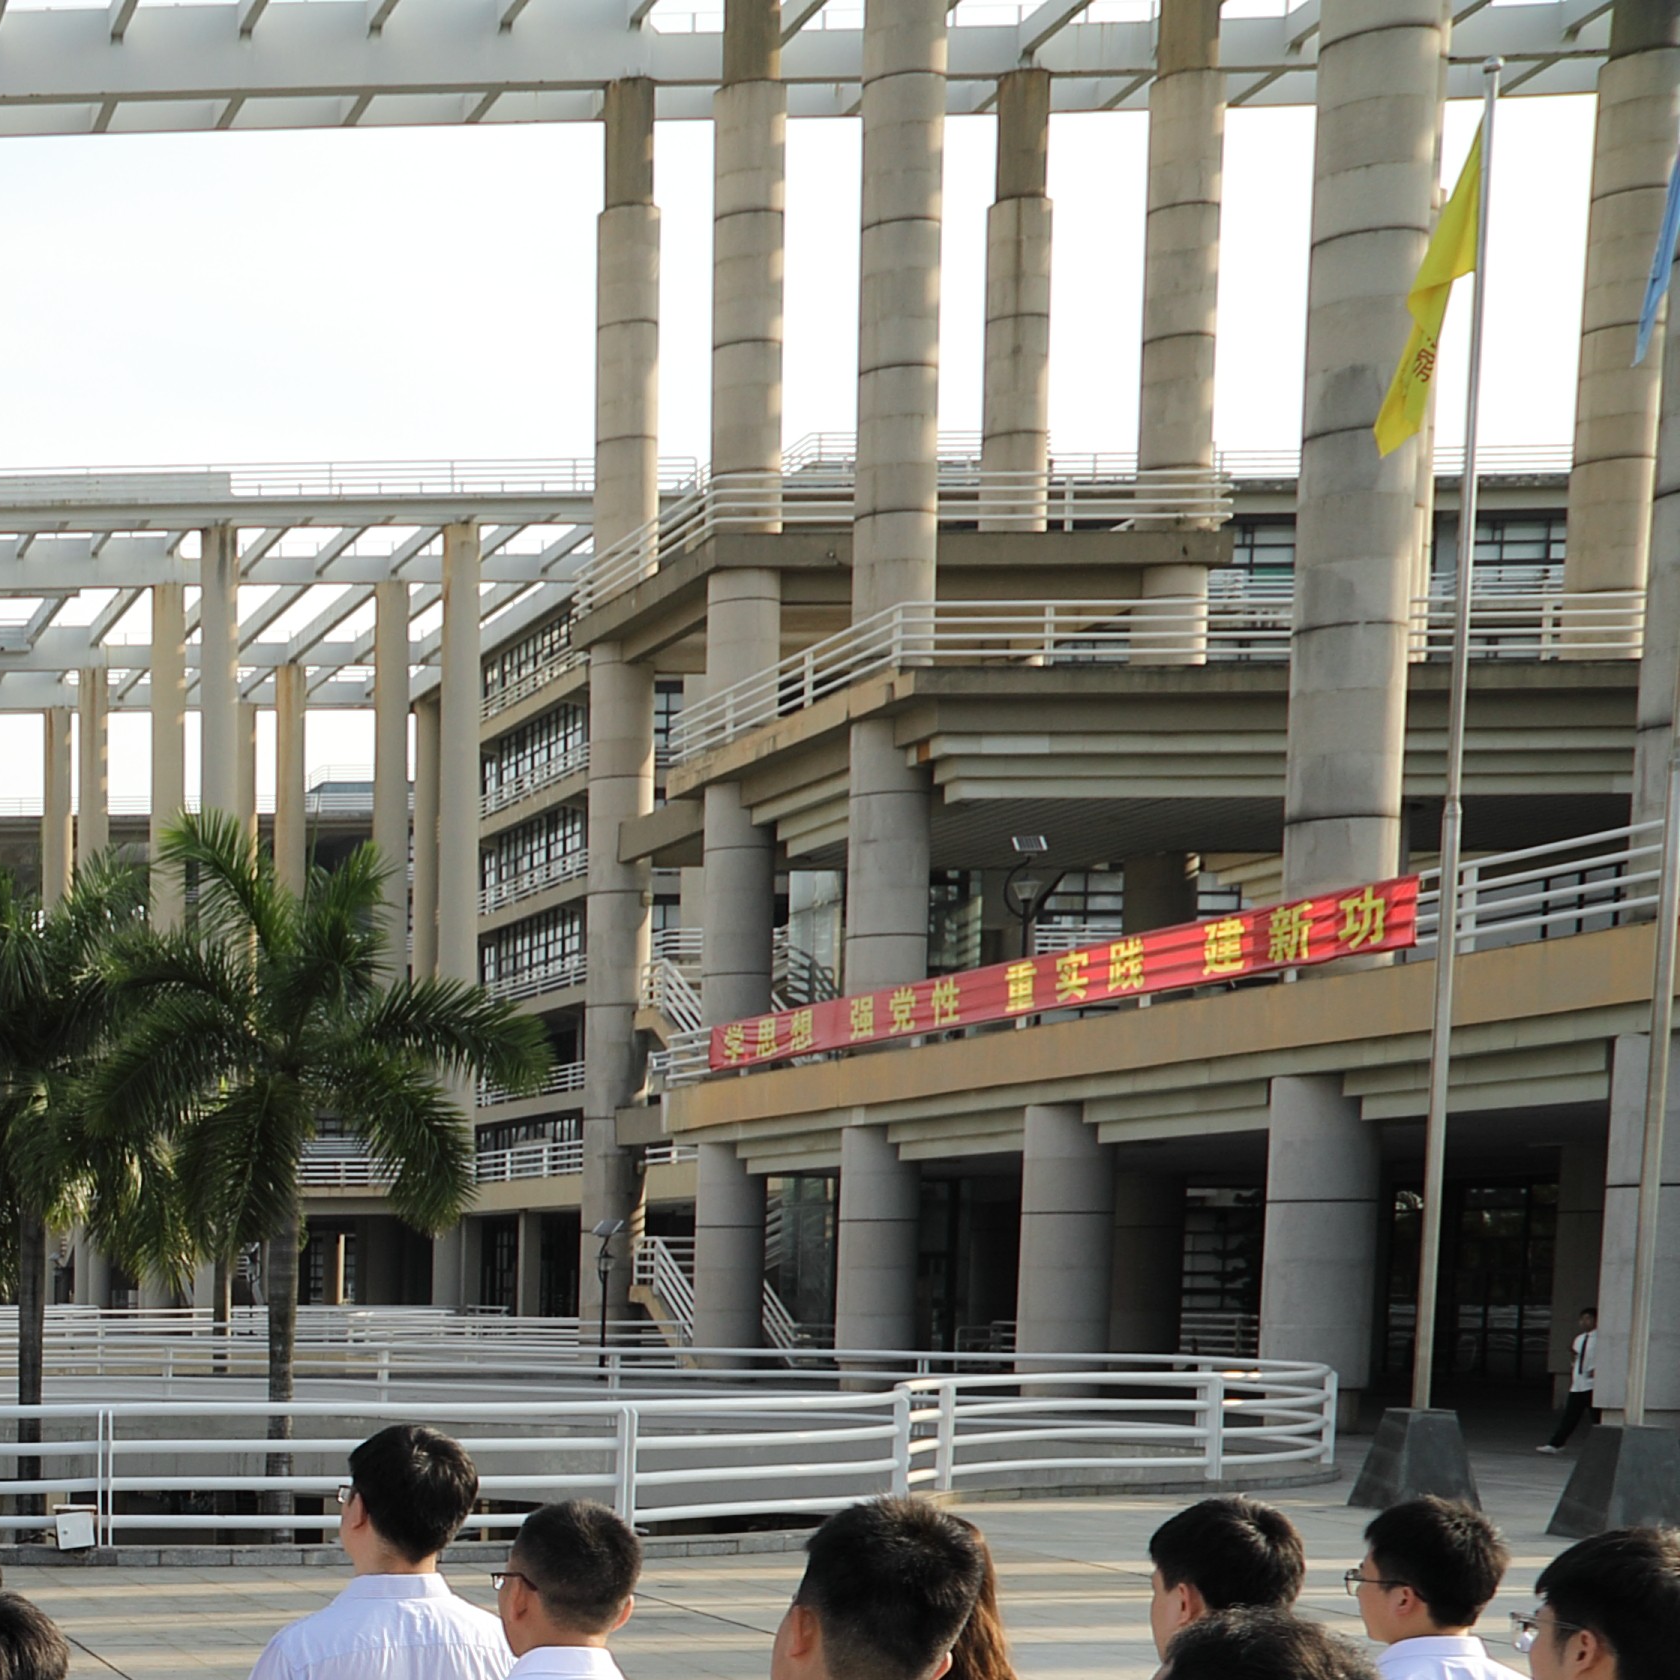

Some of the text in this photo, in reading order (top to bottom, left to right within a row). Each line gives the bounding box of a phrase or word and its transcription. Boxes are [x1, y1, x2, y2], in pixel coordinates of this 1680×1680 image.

[721, 885, 1387, 1065] 学思想 强党性 重实践 建新功
